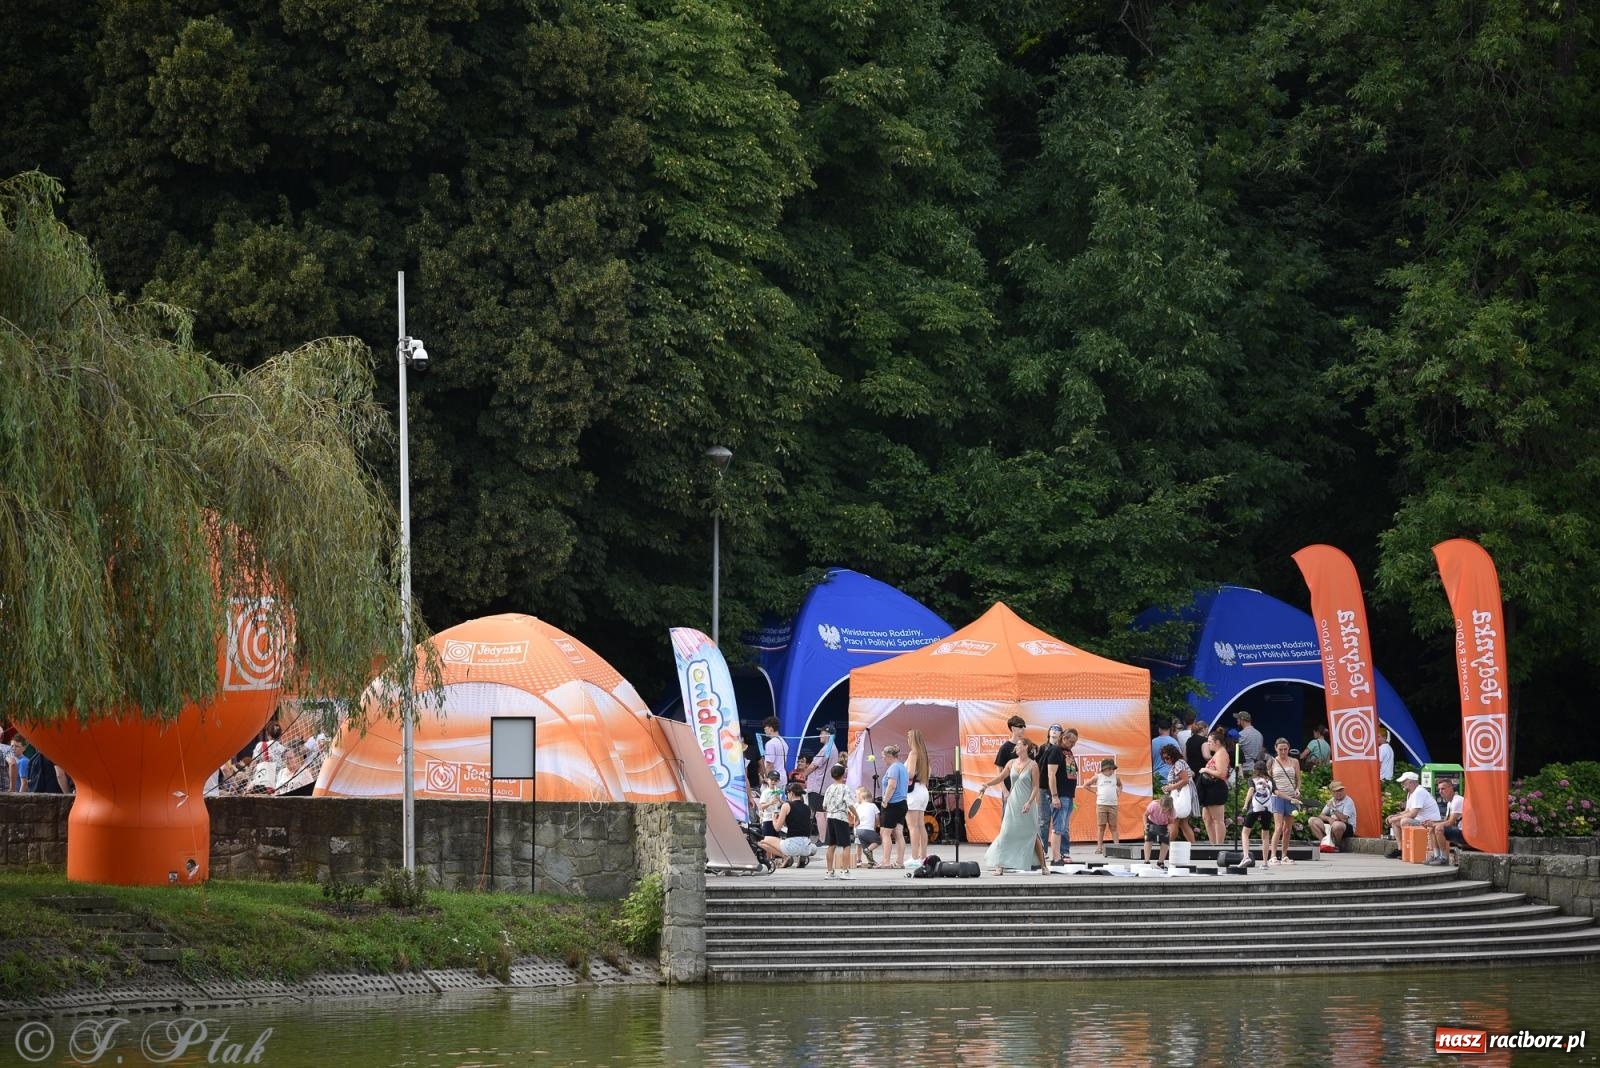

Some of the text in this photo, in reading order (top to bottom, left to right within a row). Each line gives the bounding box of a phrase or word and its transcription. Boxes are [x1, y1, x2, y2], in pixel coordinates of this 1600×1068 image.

[840, 627, 888, 637] Ministerstwo
[843, 636, 863, 646] Pracy
[868, 638, 896, 647] Polityki
[1235, 643, 1281, 651] Ministerstwo
[477, 644, 523, 658] Jedynka
[1238, 651, 1258, 660] Pracy
[1263, 649, 1290, 660] Polityki
[1291, 648, 1321, 658] Społecz
